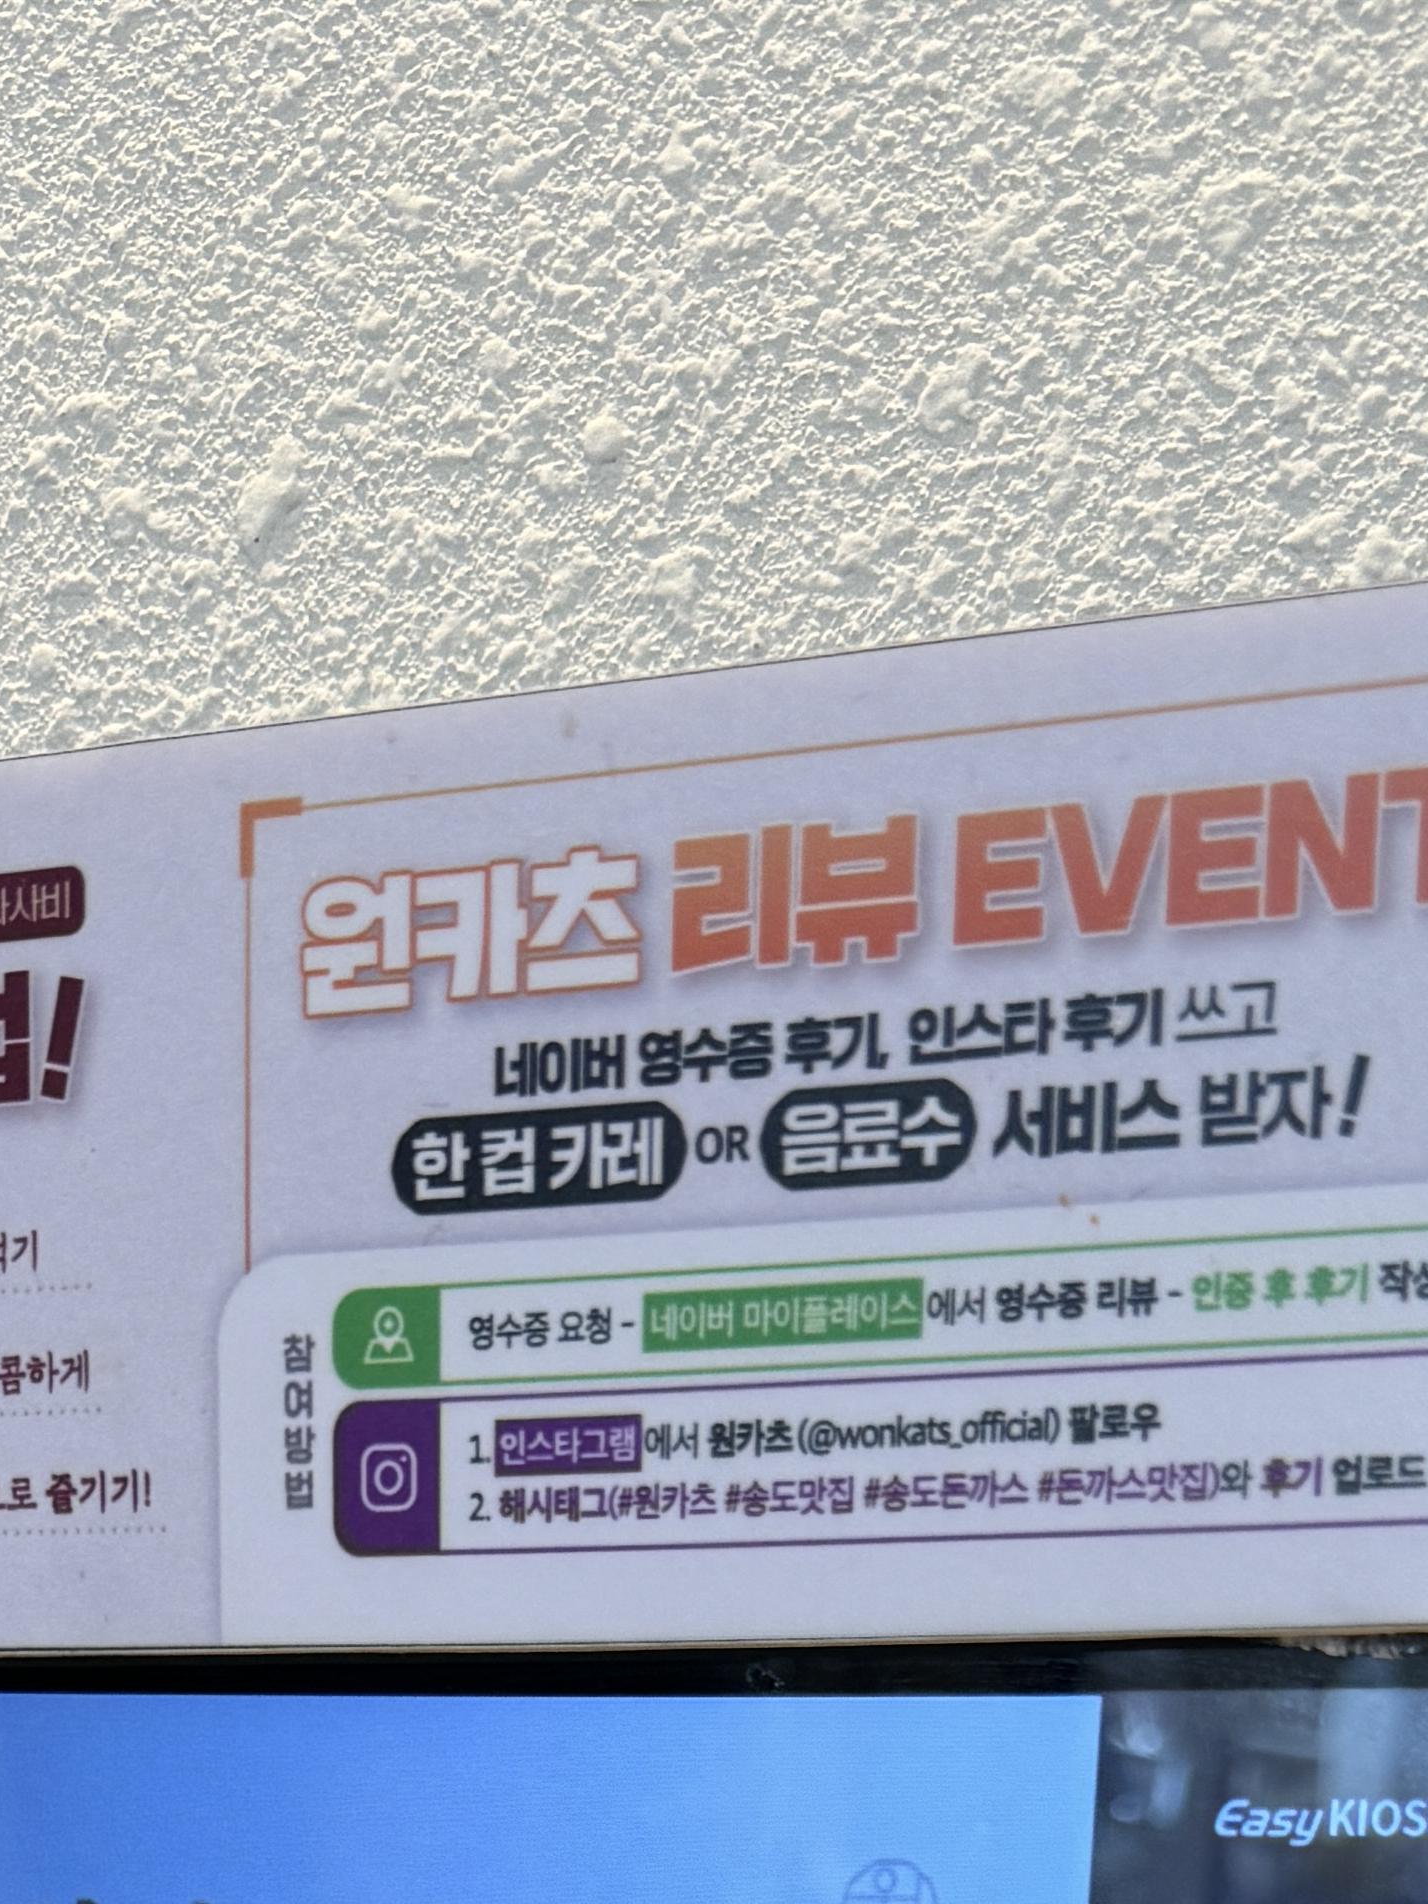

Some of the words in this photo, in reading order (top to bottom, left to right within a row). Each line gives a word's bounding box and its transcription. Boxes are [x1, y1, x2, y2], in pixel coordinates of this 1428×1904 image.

[301, 844, 642, 1019] 원카츠
[672, 814, 918, 973] 리뷰
[494, 1035, 625, 1098] 네이버
[638, 1023, 772, 1085] 영수증
[784, 1012, 889, 1070] 후기,
[908, 997, 1051, 1065] 인스타
[1063, 987, 1164, 1048] 후기
[1176, 979, 1277, 1041] 쓰고
[548, 1117, 664, 1190] 카레
[695, 1125, 750, 1164] OR
[780, 1094, 963, 1176] 음료수
[992, 1078, 1180, 1158] 서비스
[1200, 1052, 1370, 1148] 받자!
[468, 1308, 551, 1351] 영수증
[558, 1307, 612, 1347] 요청
[650, 1302, 735, 1341] 네이버
[996, 1281, 1086, 1324] 영수증
[1096, 1277, 1160, 1318] 리뷰
[1191, 1269, 1254, 1313] 인증
[1264, 1267, 1296, 1307] 후
[1305, 1264, 1369, 1306] 후기
[1068, 1402, 1161, 1445] 팔로우
[45, 1469, 151, 1515] 즐기기!
[725, 1476, 855, 1518] #송도맛집
[863, 1467, 1029, 1515] #송도돈까스
[1260, 1456, 1324, 1499] 후기
[1332, 1454, 1426, 1495] 업로드
